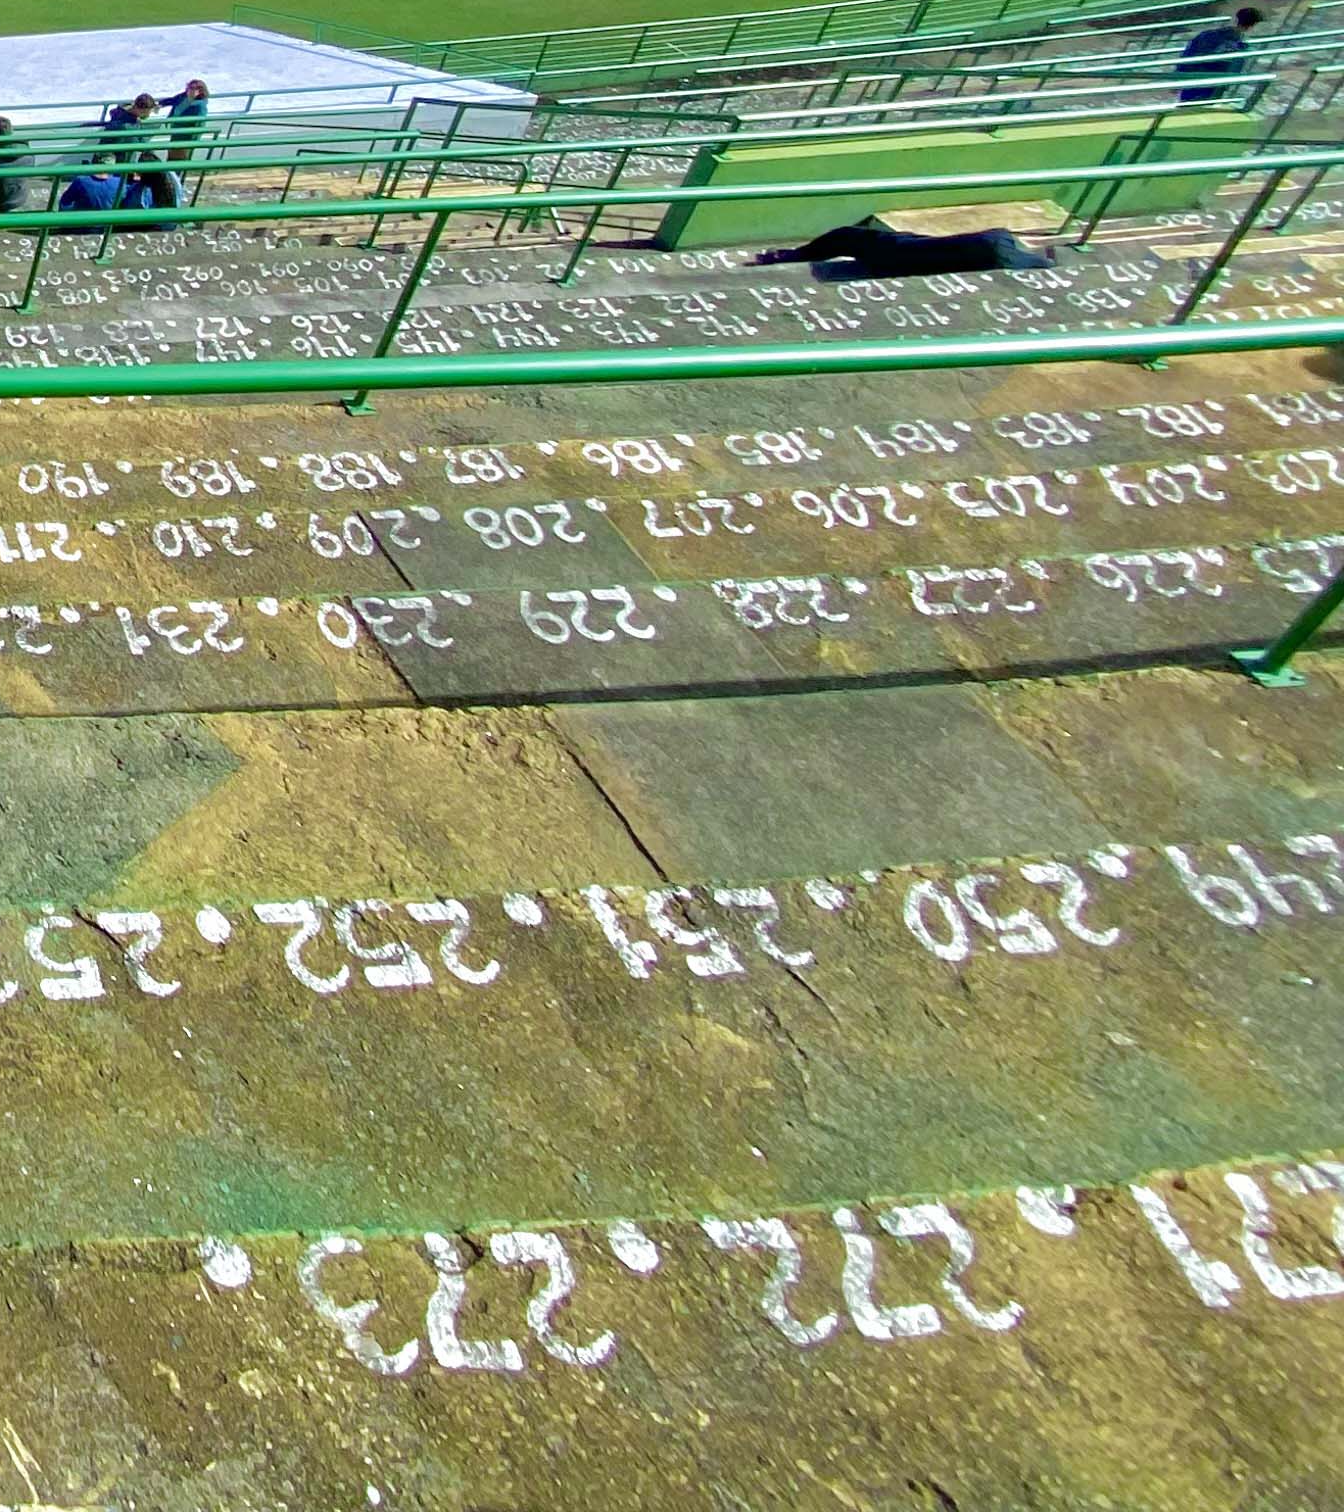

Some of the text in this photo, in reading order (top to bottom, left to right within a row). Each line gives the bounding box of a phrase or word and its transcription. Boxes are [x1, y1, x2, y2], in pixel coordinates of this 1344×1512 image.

[559, 298, 624, 318] 123
[652, 292, 717, 313] 122
[884, 304, 950, 327] 140
[5, 324, 64, 347] 129
[195, 316, 254, 338] 127
[291, 314, 351, 335] 126
[492, 324, 560, 347] 144
[195, 339, 257, 363] 147
[290, 336, 358, 358] 146
[854, 420, 960, 458] 184
[994, 412, 1090, 449] 183
[1117, 403, 1224, 439] 182
[444, 448, 524, 484] 187
[582, 439, 683, 476] 186
[723, 428, 822, 466] 185
[18, 461, 110, 498] 190
[161, 458, 256, 497] 189
[298, 451, 401, 491] 188
[1100, 464, 1227, 507] 204
[640, 496, 755, 537] 207
[790, 485, 916, 529] 206
[943, 476, 1070, 518] 205
[152, 516, 253, 558] 210
[308, 509, 421, 558] 209
[463, 500, 585, 550] 208
[908, 566, 1036, 615] 227
[1084, 550, 1223, 602] 226
[317, 596, 453, 649] 230
[520, 586, 655, 644] 229
[712, 576, 850, 629] 228
[116, 601, 243, 656] 231
[583, 885, 813, 978] 251
[905, 862, 1119, 961] 250
[253, 895, 499, 993] 252
[700, 1200, 1025, 1345] 272
[300, 1232, 616, 1375] 273
